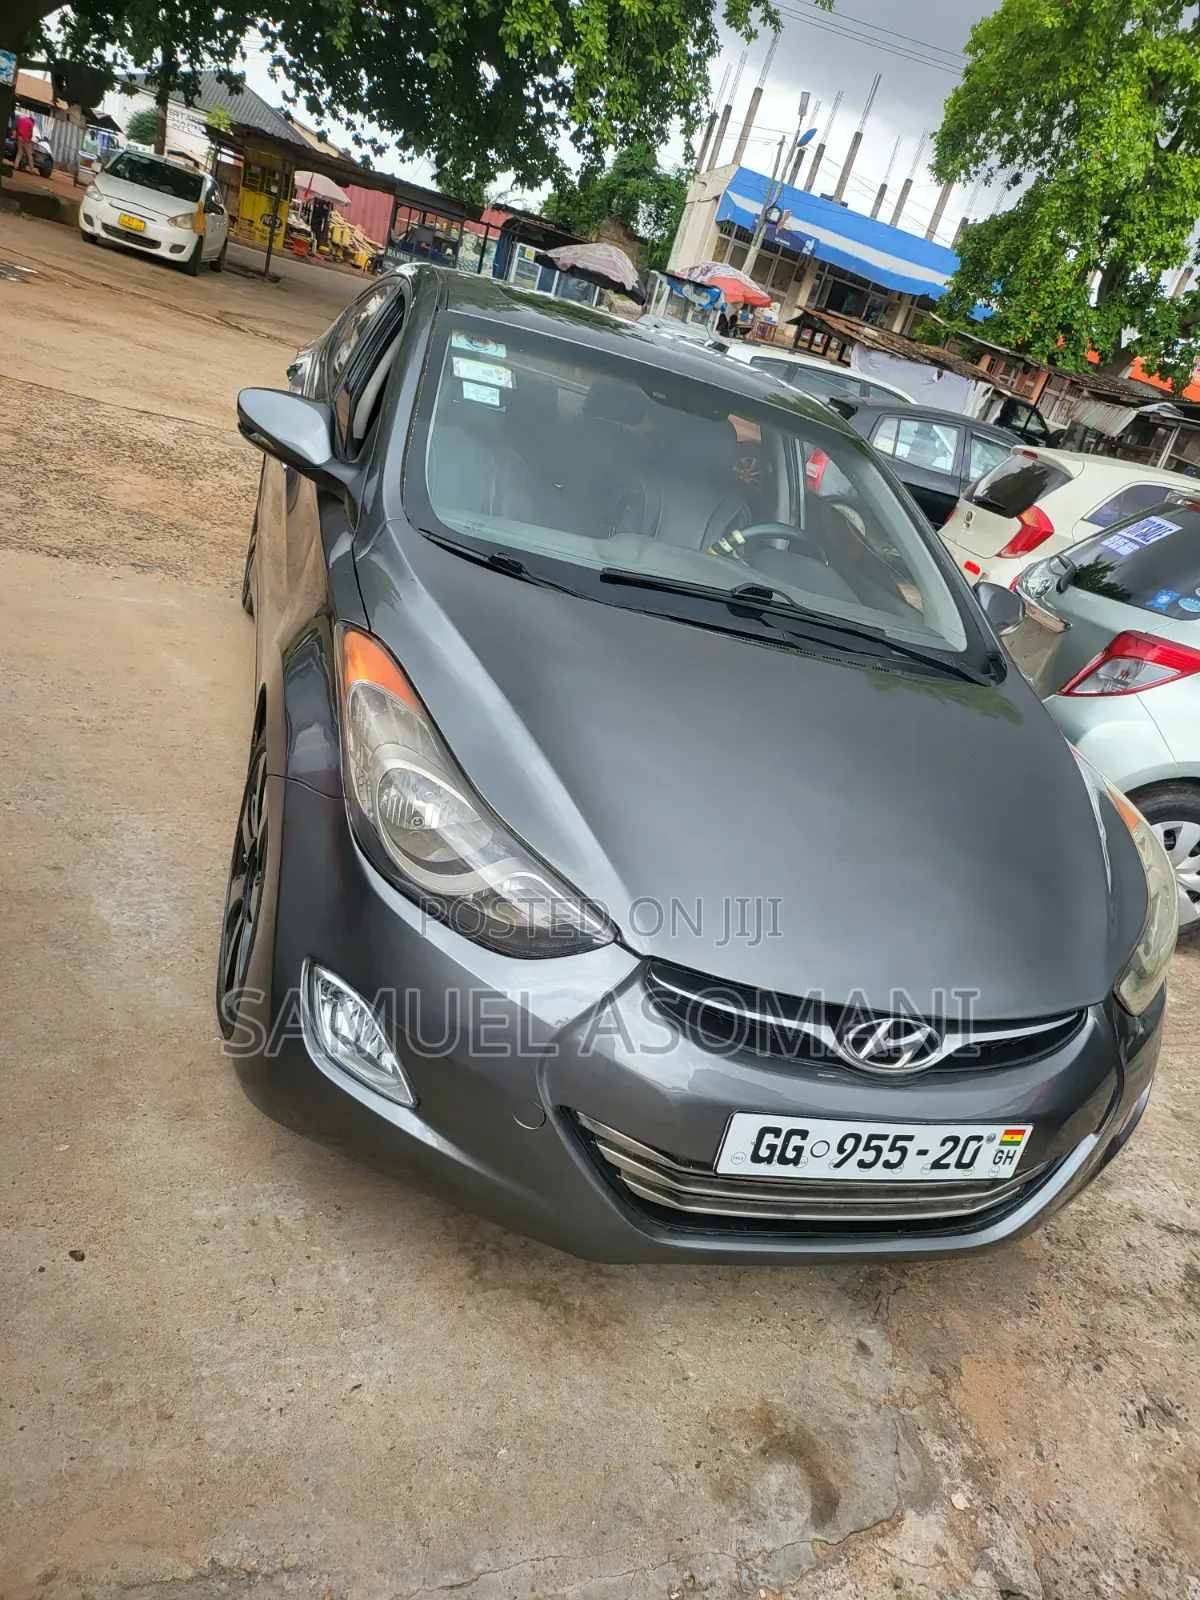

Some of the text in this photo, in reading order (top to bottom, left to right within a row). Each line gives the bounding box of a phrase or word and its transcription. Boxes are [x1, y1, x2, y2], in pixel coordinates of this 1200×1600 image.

[750, 1126, 983, 1170] GG 955-20
[992, 1149, 1016, 1167] GH
